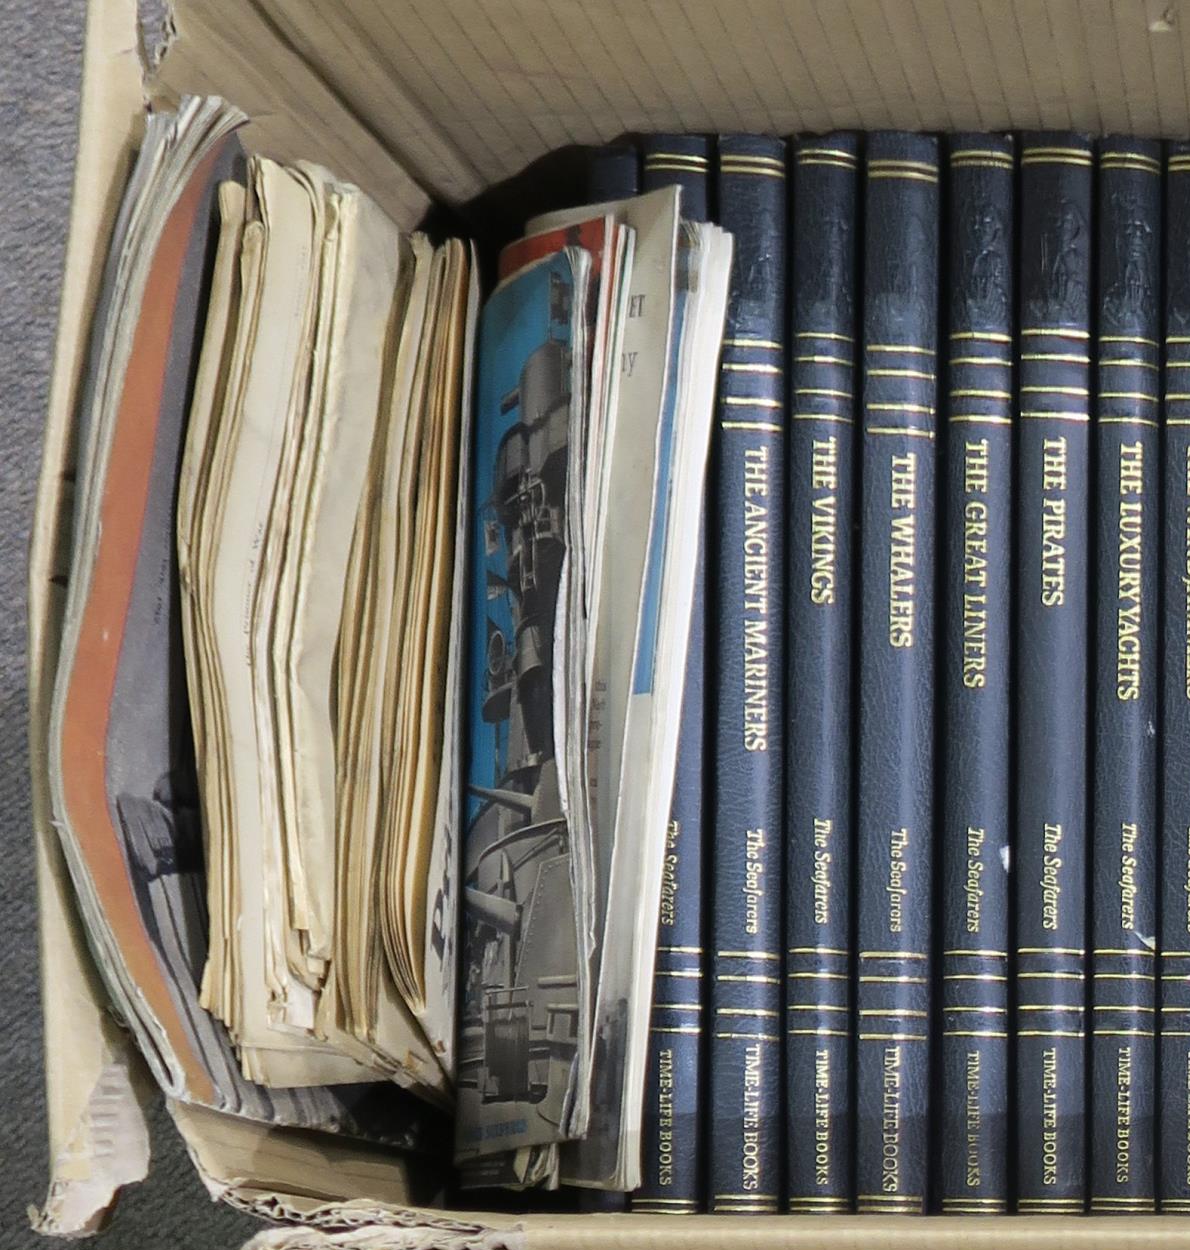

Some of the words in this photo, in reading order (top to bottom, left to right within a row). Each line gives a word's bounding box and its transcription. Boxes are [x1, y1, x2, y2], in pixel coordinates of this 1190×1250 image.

[744, 446, 768, 496] THE
[813, 437, 836, 489] THE
[892, 453, 917, 508] THE
[965, 439, 988, 493] THE
[1043, 437, 1067, 490] THE
[1121, 441, 1143, 495] THE
[744, 501, 768, 613] ANCIENT
[811, 496, 836, 605] VIKINGS
[890, 515, 914, 647] WHALERS
[964, 501, 988, 587] GREAT
[1041, 498, 1066, 606] PIRATES
[1119, 502, 1142, 601] LUXURY
[963, 594, 986, 688] LINERS
[1117, 602, 1140, 701] YACHTS
[744, 620, 768, 751] MARINERS
[814, 818, 830, 849] The
[1043, 823, 1061, 852] The
[813, 852, 829, 924] Seafarers
[1040, 855, 1061, 930] Seafarers
[743, 1044, 760, 1128] TIME-LIFE
[1043, 1047, 1056, 1128] TIME-LIFE
[743, 1130, 759, 1190] BOOKS
[1043, 1131, 1056, 1184] BOOKS
